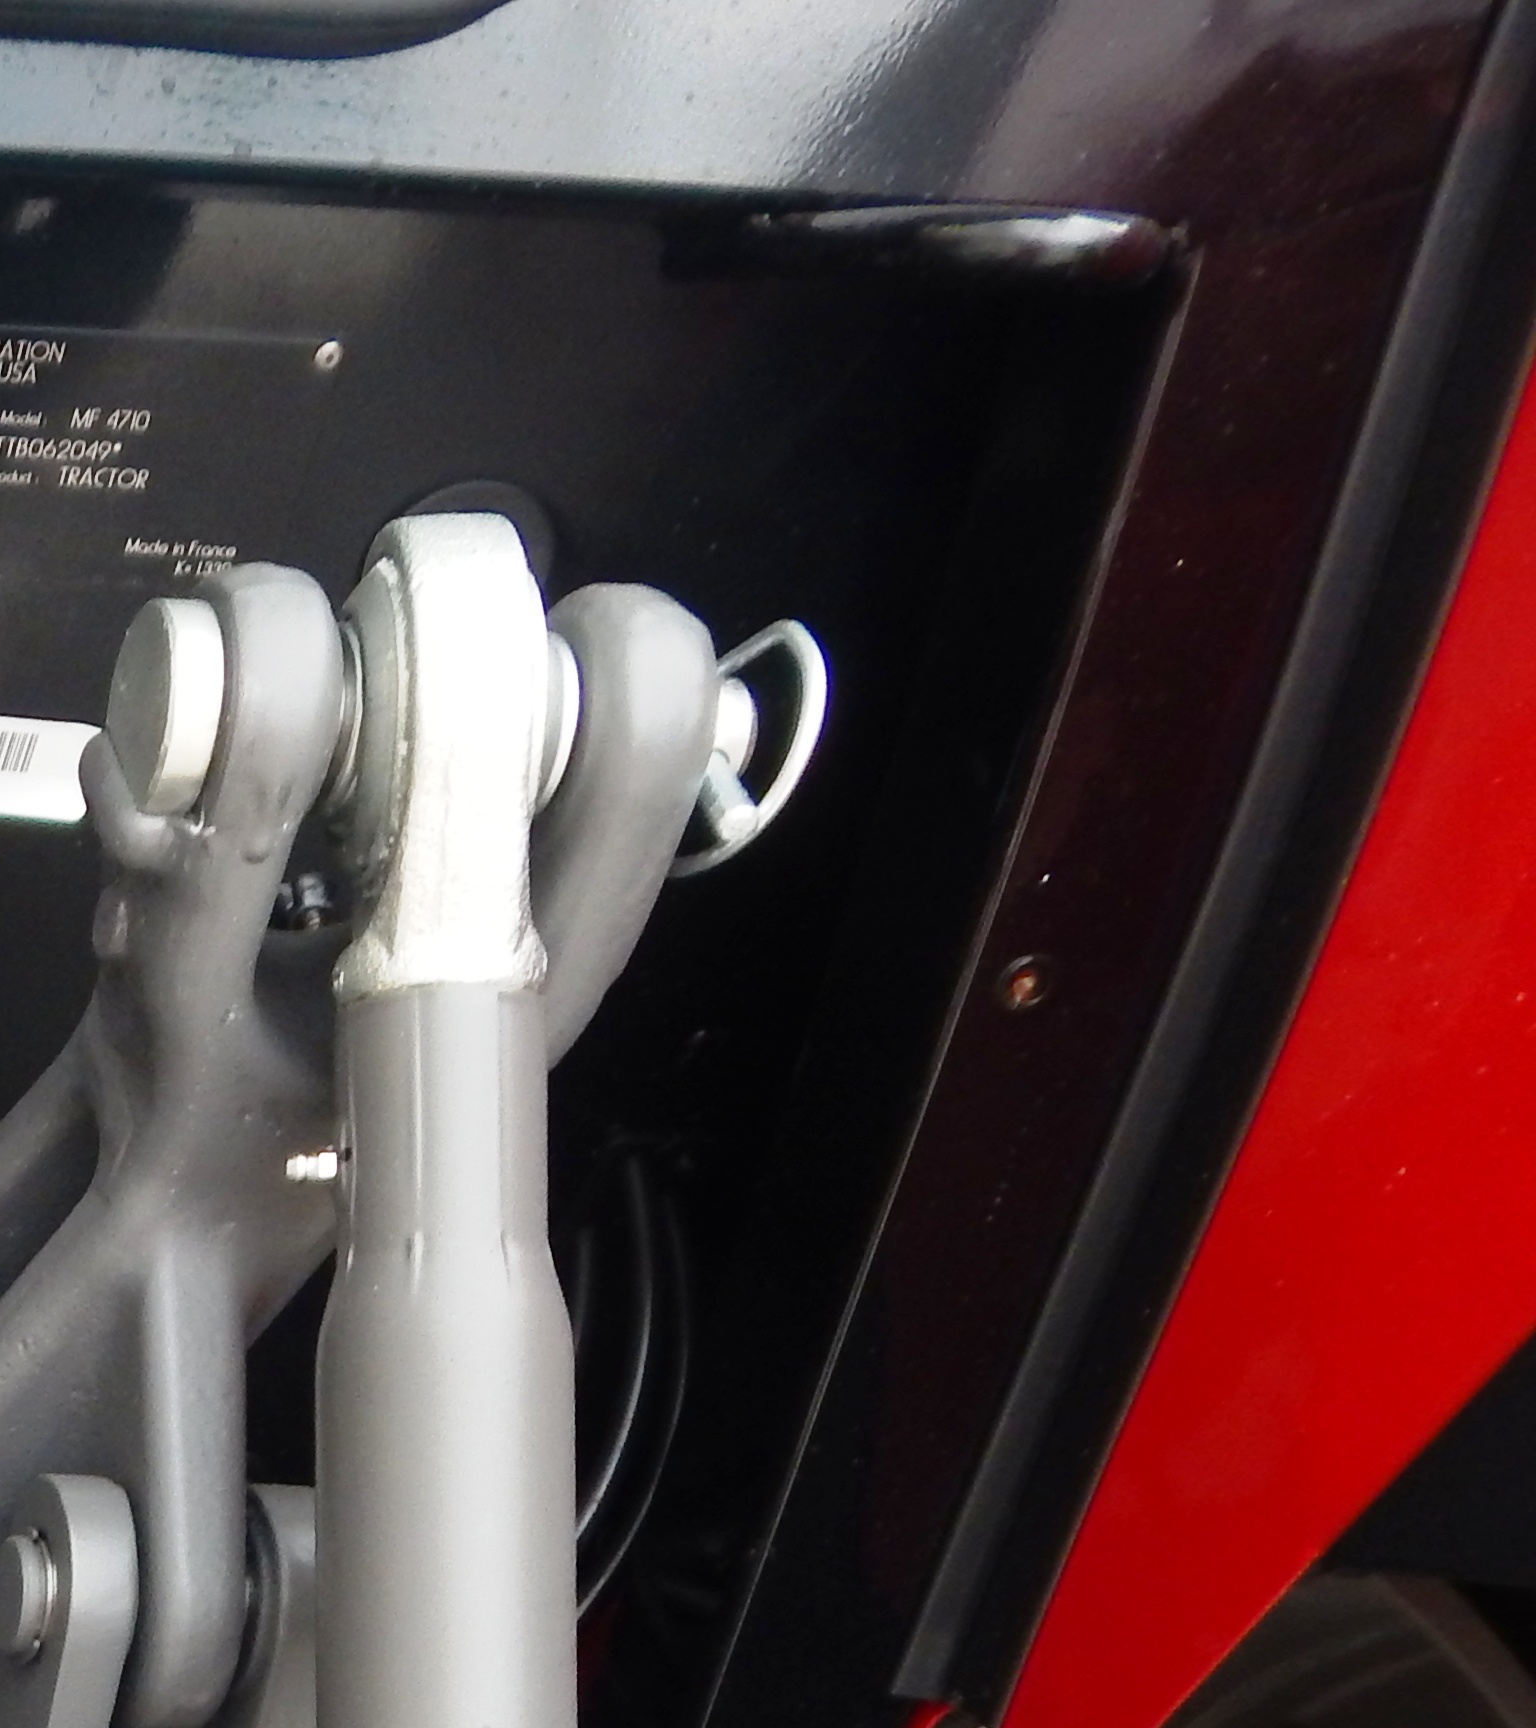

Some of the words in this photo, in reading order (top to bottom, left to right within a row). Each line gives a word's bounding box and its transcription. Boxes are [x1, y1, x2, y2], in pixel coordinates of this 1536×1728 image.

[70, 406, 102, 430] MF
[106, 408, 152, 432] 4710
[58, 465, 151, 490] TRACTOR
[125, 537, 169, 556] Made
[172, 540, 186, 556] in
[188, 539, 238, 559] France
